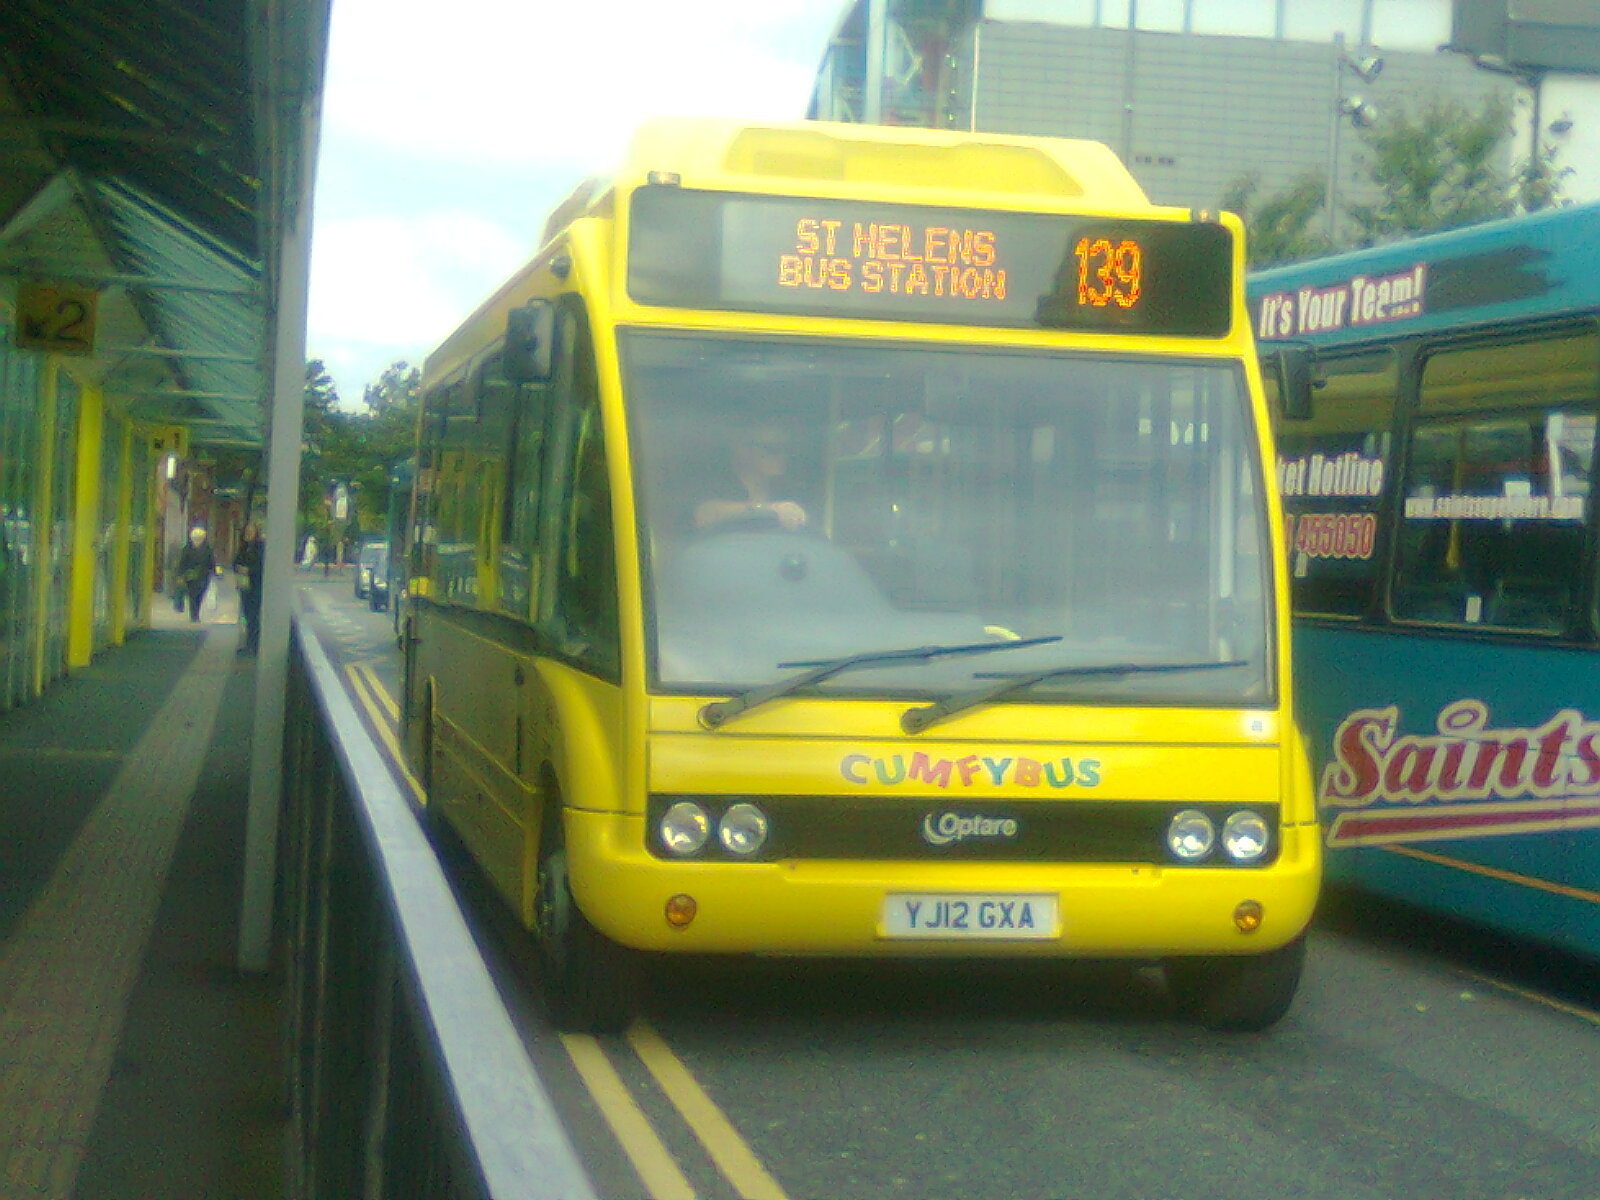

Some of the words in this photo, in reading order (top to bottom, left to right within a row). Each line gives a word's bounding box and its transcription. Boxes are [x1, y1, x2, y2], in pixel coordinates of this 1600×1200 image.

[796, 217, 841, 256] ST
[853, 222, 996, 267] HELENS
[778, 254, 852, 291] BUS
[861, 261, 1006, 301] STATION
[1074, 237, 1142, 309] 139
[57, 299, 86, 342] 2
[1258, 295, 1294, 338] It's
[1297, 288, 1347, 334] Your
[1350, 263, 1425, 324] Team!
[1307, 451, 1384, 497] Hotline
[840, 752, 1101, 788] CUMFYBUS
[1320, 699, 1600, 807] Saints
[905, 901, 969, 929] YJ12
[978, 901, 1035, 929] GXA
